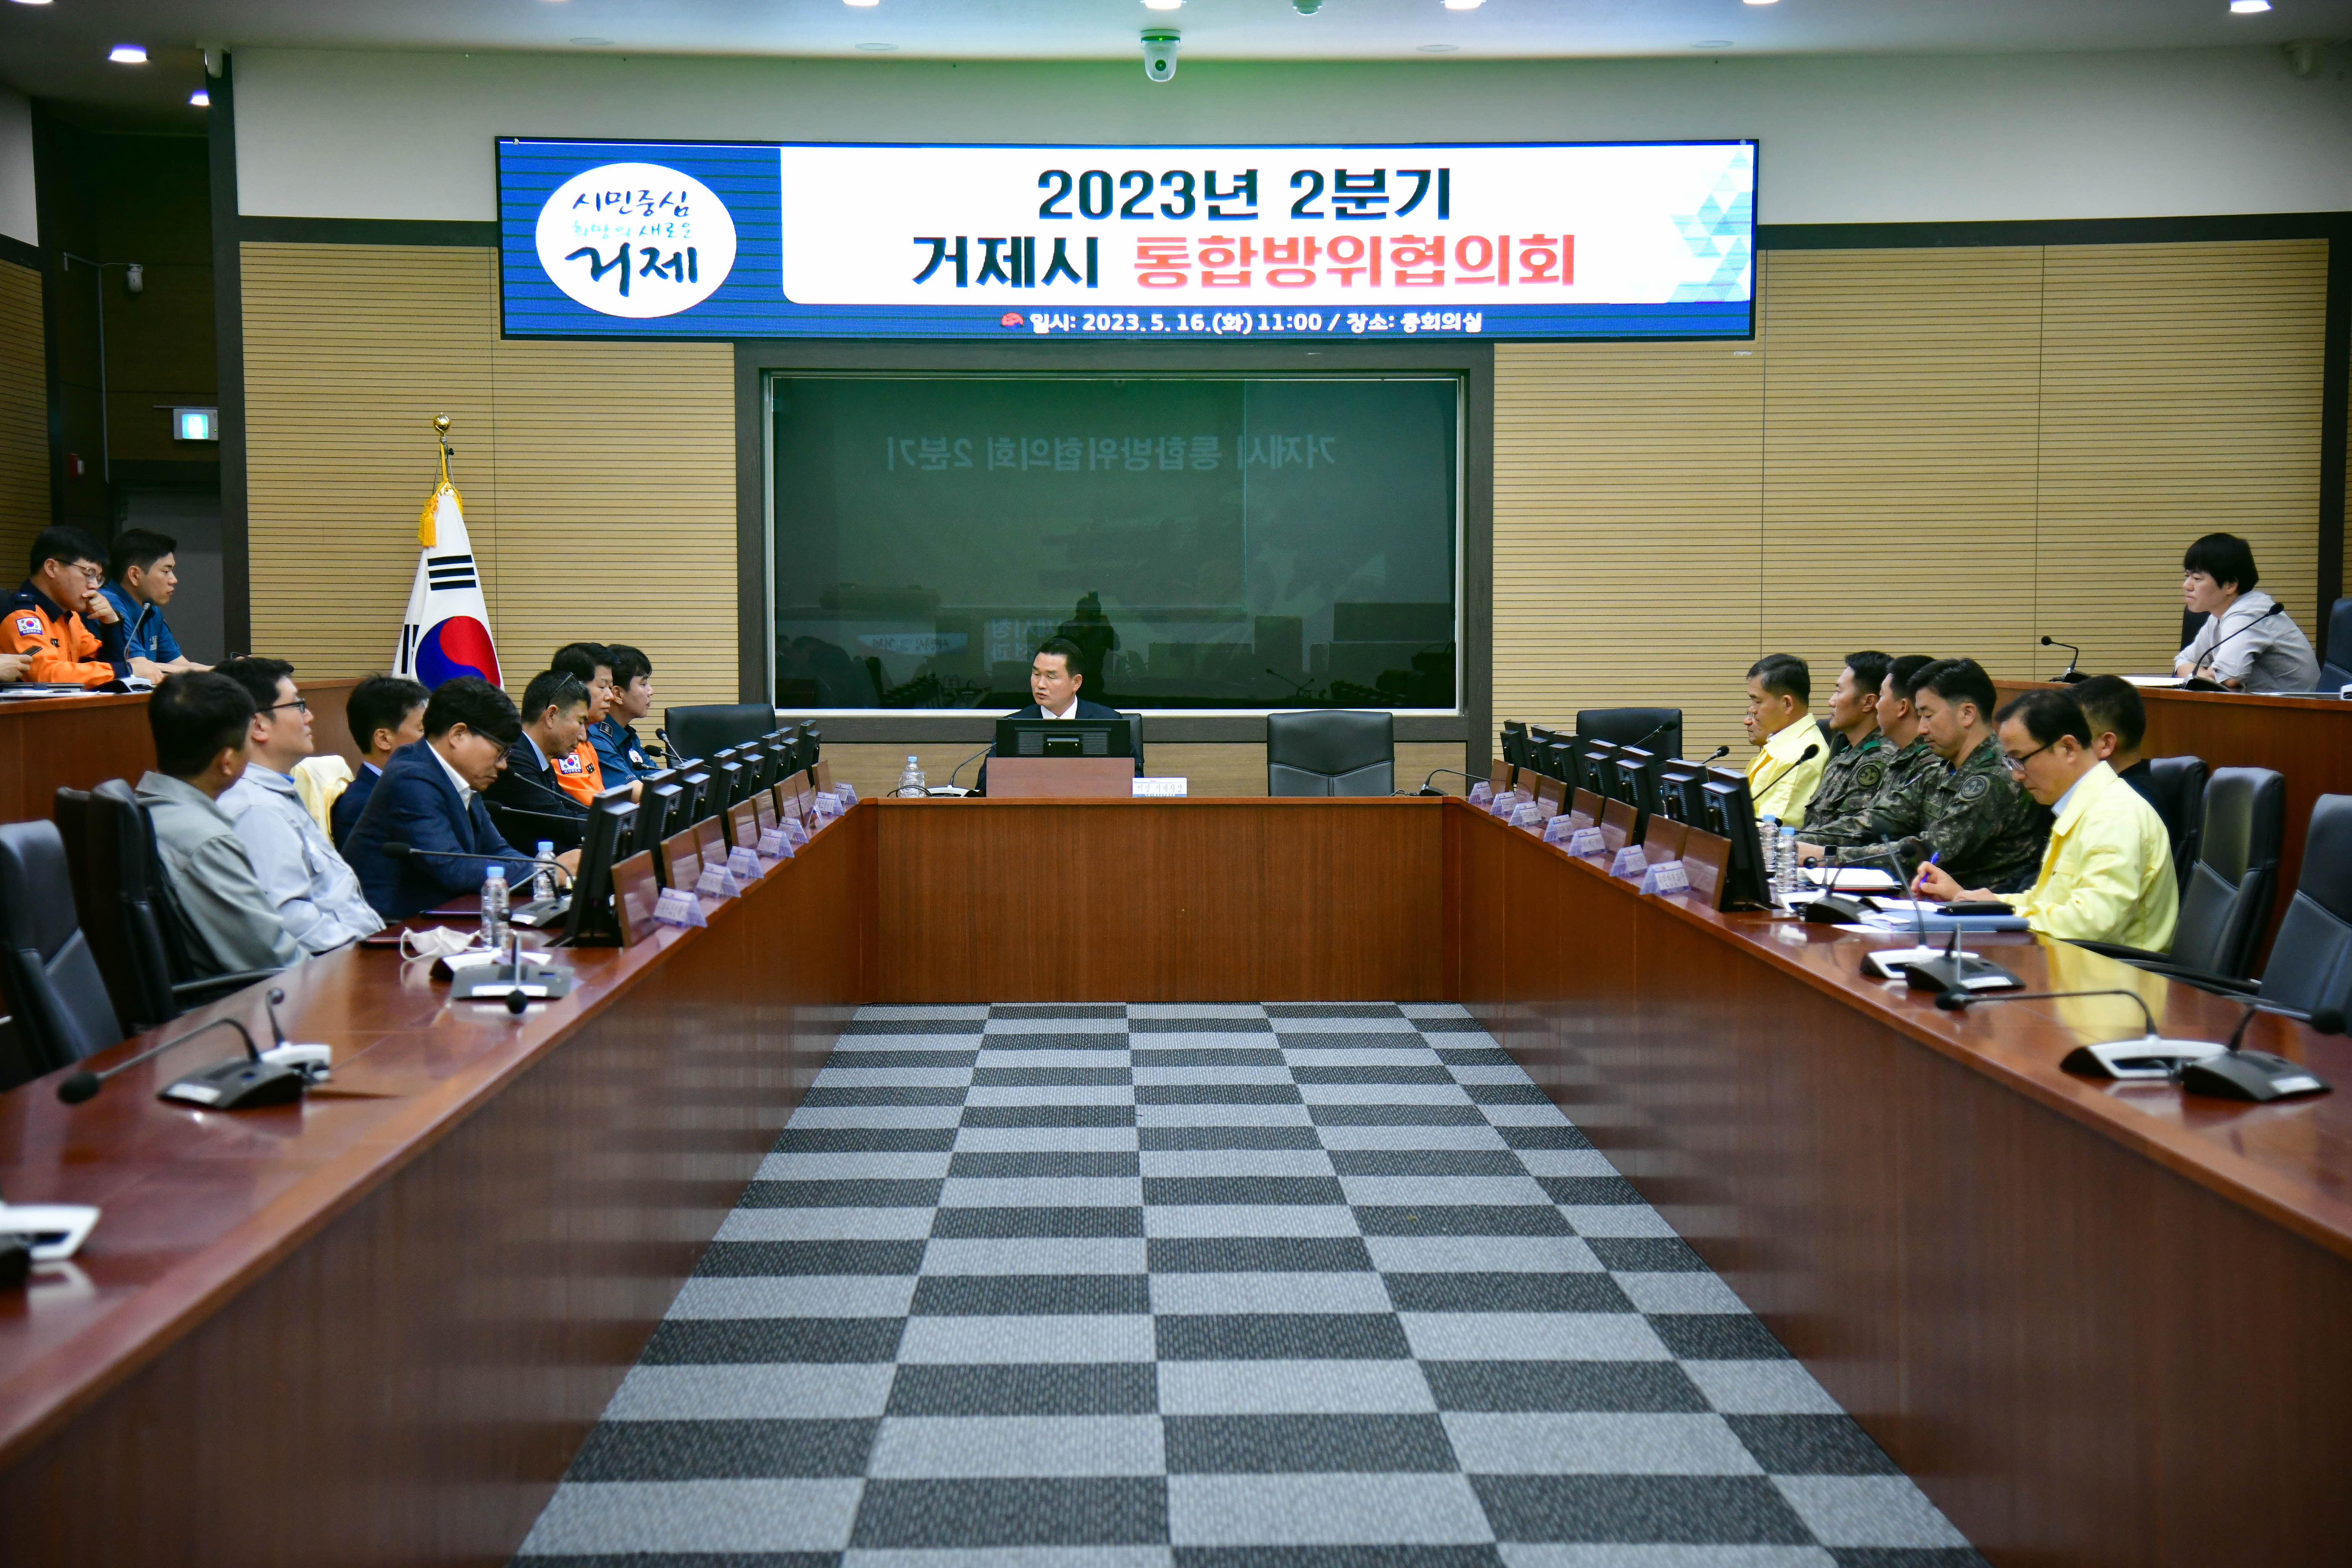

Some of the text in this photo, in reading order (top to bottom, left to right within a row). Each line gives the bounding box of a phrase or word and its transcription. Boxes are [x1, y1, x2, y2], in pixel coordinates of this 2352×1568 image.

[572, 190, 689, 217] 시민중심
[1038, 168, 1450, 221] 2023년 2분기
[638, 222, 692, 239] 새로운
[565, 242, 698, 297] 거제
[912, 233, 1575, 289] 거제시 통합방위협의회
[1030, 313, 1076, 334] 일시:
[1083, 314, 1146, 331] 2023.
[1258, 313, 1322, 330] 11:00
[1327, 314, 1340, 331] /
[1347, 314, 1394, 333] 장소:
